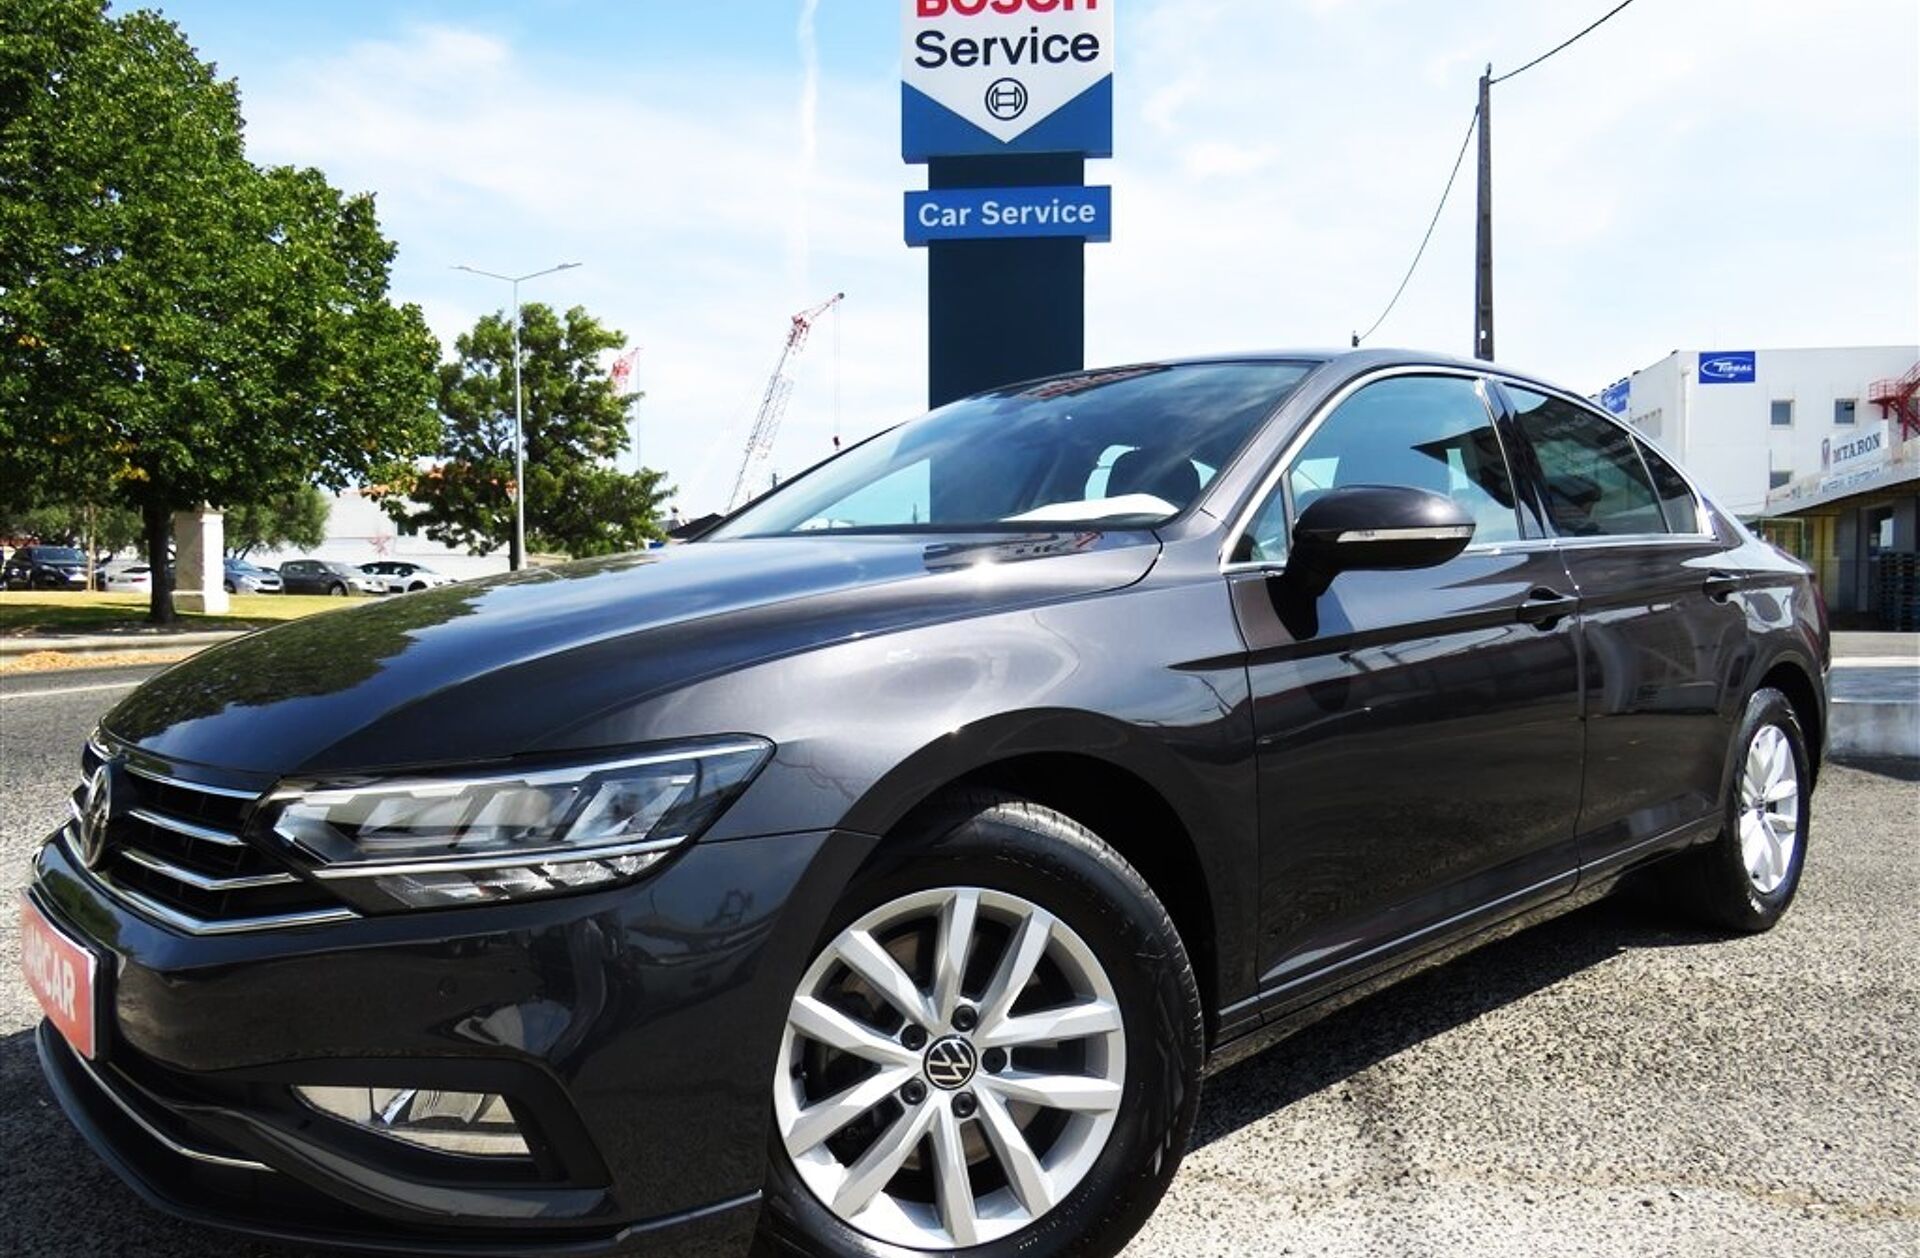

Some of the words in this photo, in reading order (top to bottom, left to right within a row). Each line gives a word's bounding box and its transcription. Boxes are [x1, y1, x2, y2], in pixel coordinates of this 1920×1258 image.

[915, 26, 1100, 69] Service
[918, 202, 971, 227] Car
[981, 199, 1096, 226] Service
